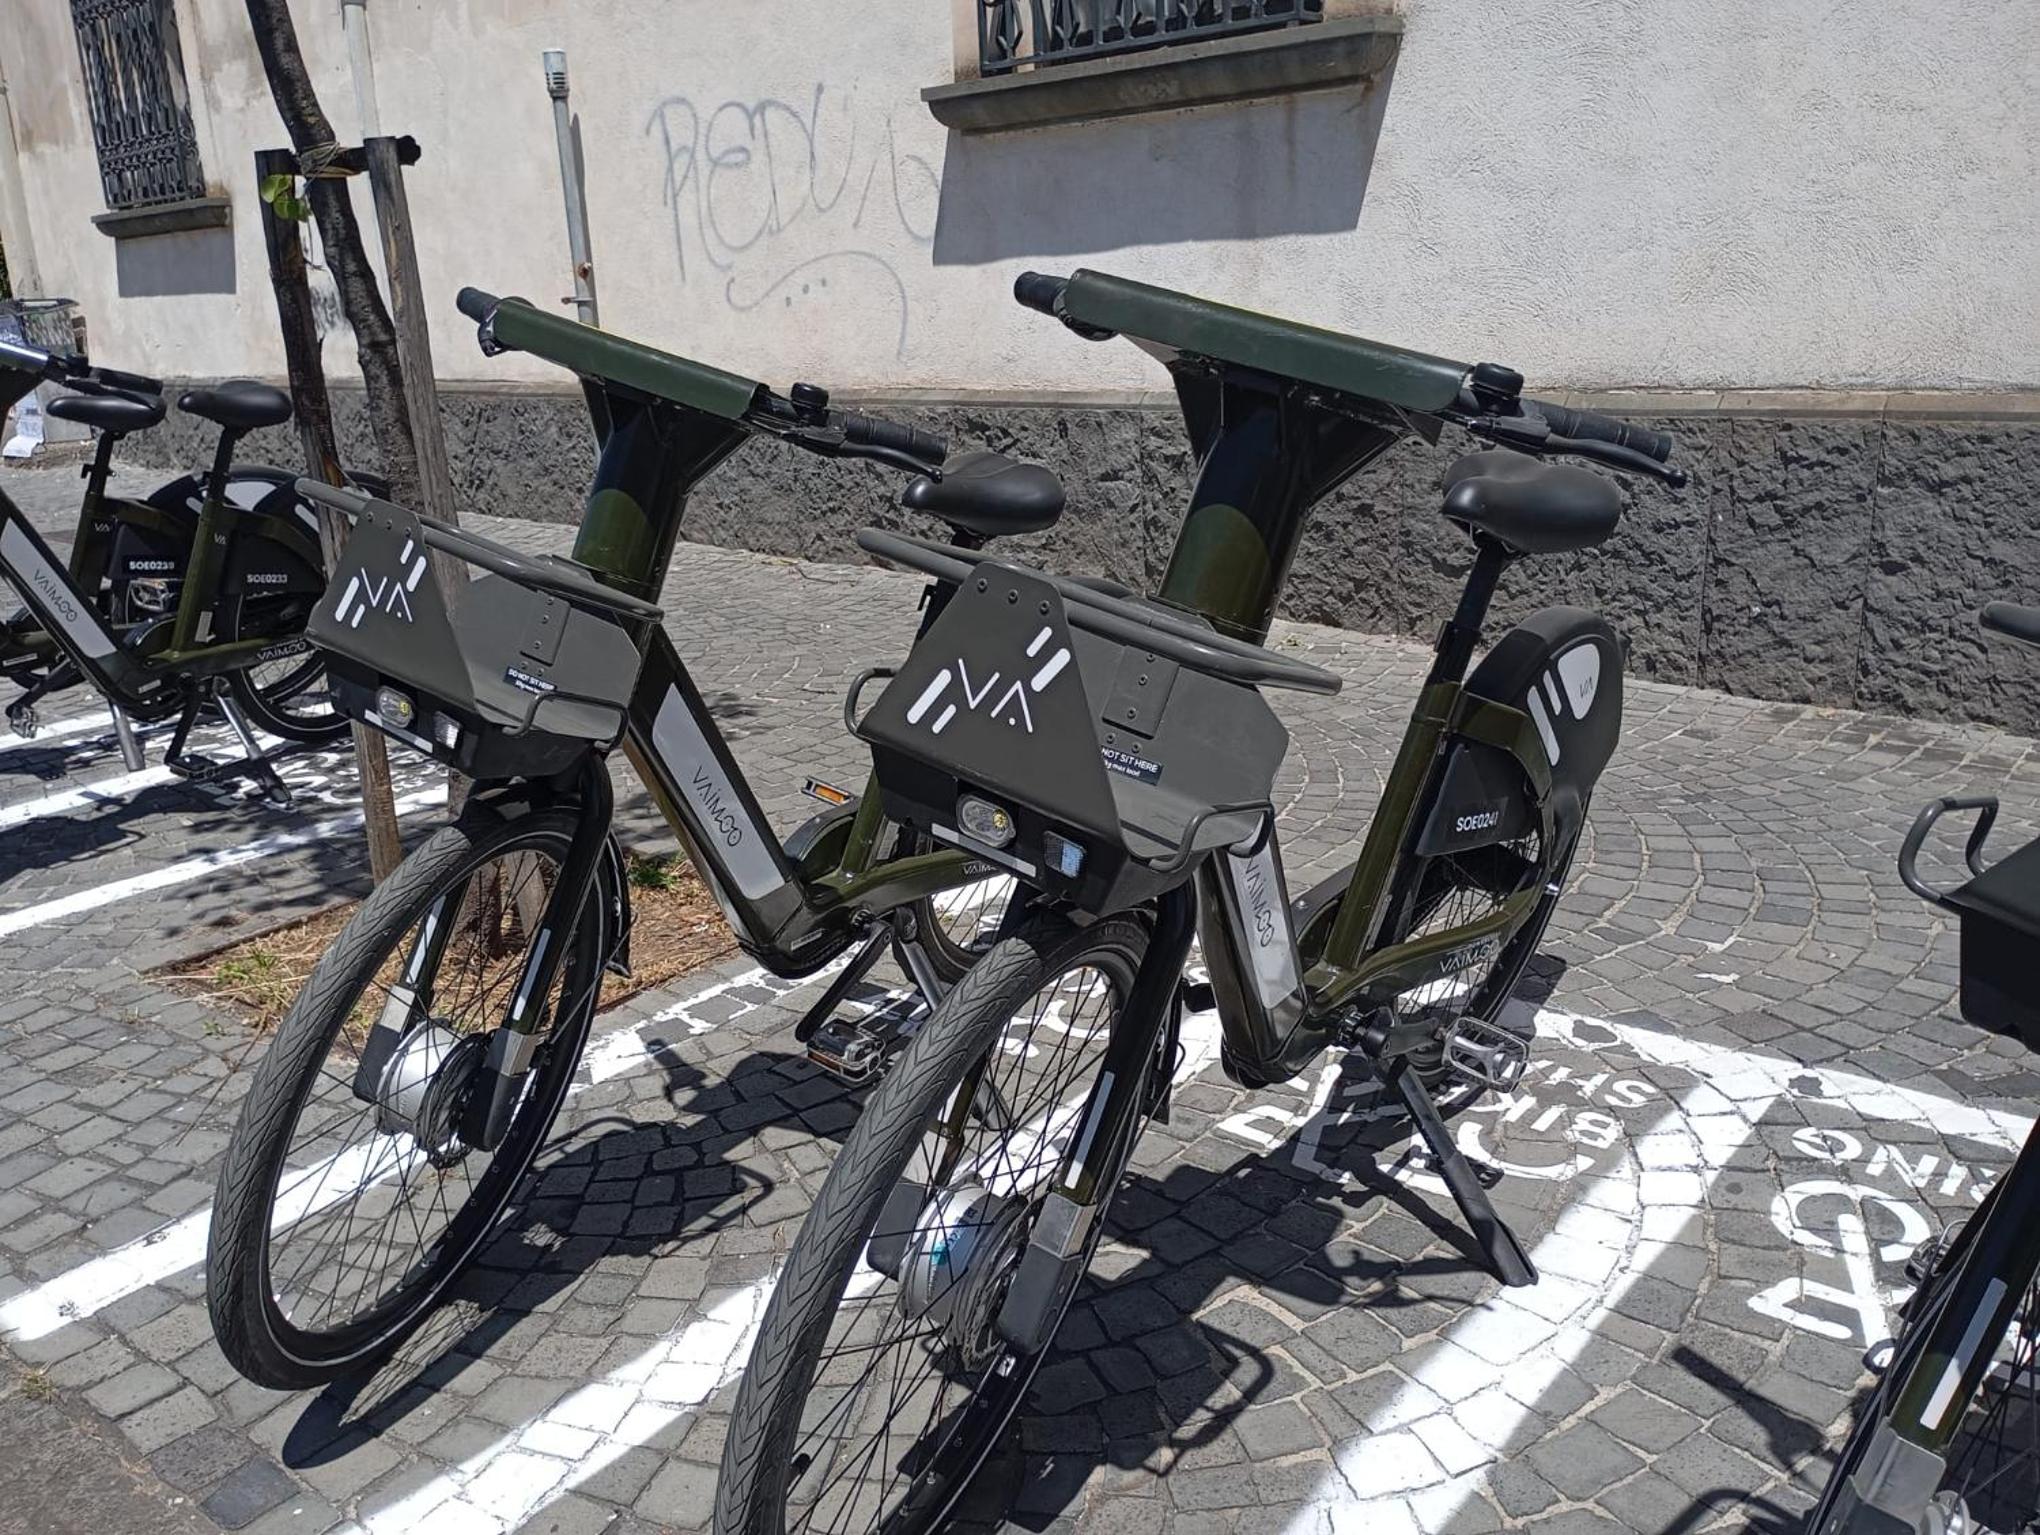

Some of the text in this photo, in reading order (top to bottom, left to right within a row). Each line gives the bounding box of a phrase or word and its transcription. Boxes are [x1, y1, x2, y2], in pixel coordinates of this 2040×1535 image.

[1120, 753, 1135, 765] SIT
[1134, 759, 1159, 774] HERE
[1455, 810, 1499, 832] SOE0241
